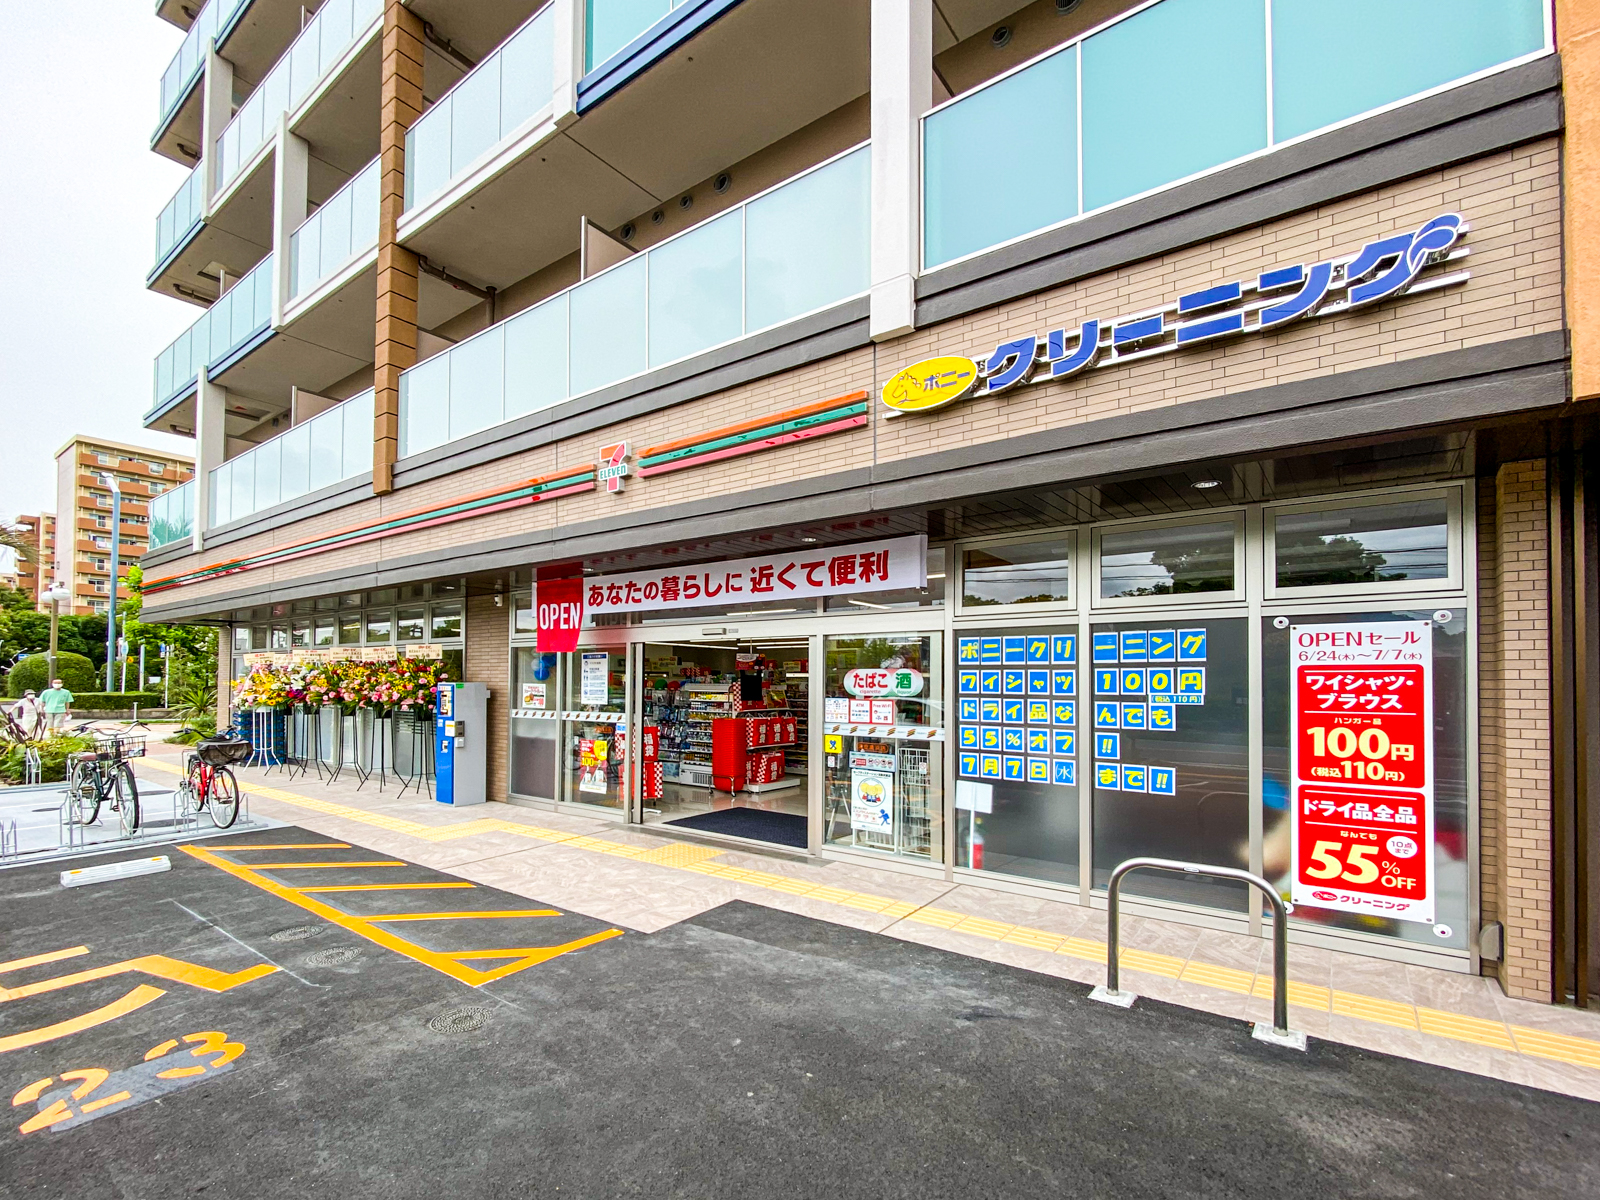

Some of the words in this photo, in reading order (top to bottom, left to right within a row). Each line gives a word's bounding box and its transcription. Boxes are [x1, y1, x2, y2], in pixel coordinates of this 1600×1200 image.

[923, 370, 970, 392] ポニー
[986, 212, 1464, 393] クリーニング
[599, 441, 626, 492] 7
[588, 573, 743, 607] あなたの暮らしに
[750, 550, 889, 593] 近くて便利
[539, 602, 580, 629] OPEN
[853, 672, 888, 689] たばこ
[895, 673, 912, 689] 酒
[961, 674, 1072, 690] ワイシャツ
[1102, 672, 1202, 691] 100円
[1317, 692, 1402, 709] ブラウス
[1334, 717, 1382, 725] ハンガー品
[1304, 798, 1417, 825] ドライ品全品
[1340, 830, 1377, 840] なんでも
[1380, 875, 1416, 890] OFF
[1340, 895, 1410, 911] クリーニング
[12, 1031, 246, 1134] 23
